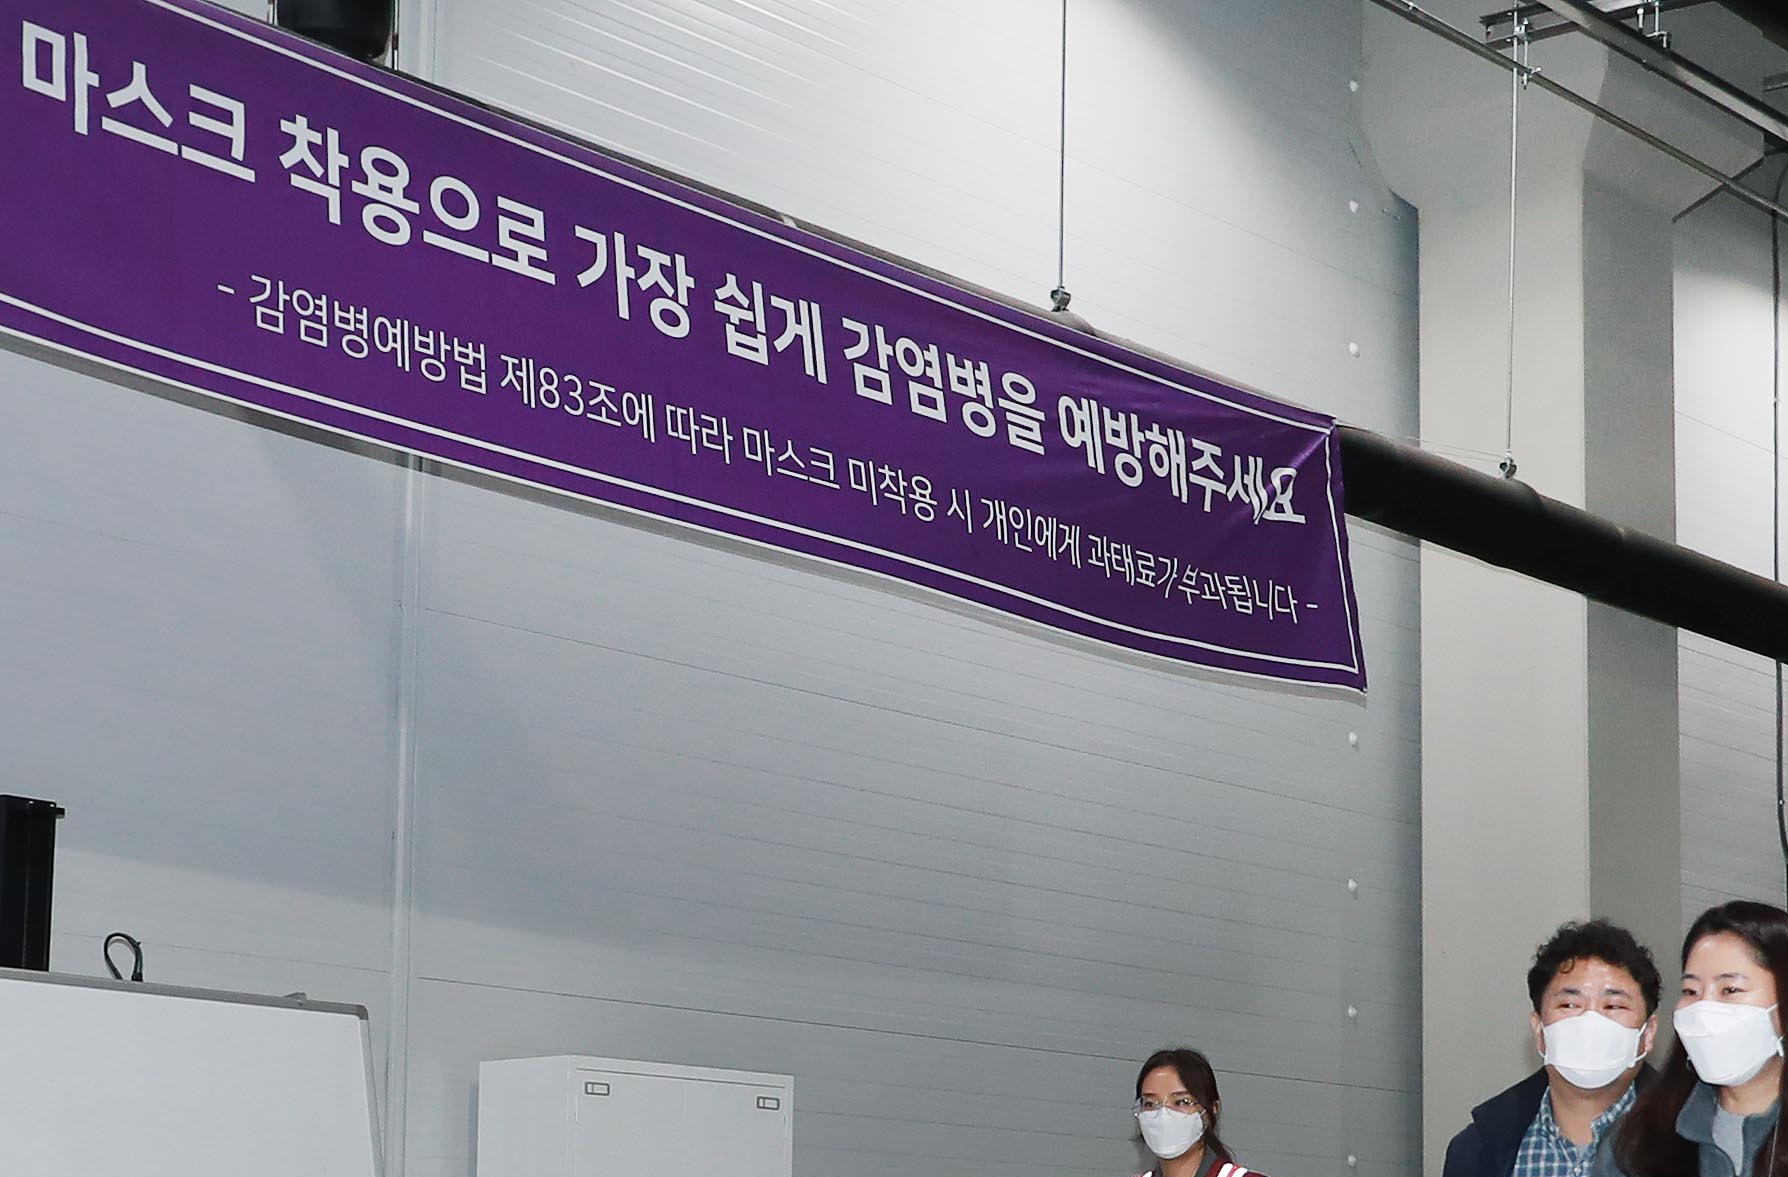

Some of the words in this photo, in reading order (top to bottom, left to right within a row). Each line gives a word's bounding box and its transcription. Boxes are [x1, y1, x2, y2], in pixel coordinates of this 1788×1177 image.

[22, 20, 256, 183] 마스크
[278, 113, 556, 286] 착용으로
[574, 224, 695, 338] 가장
[713, 272, 828, 385] 쉽게
[841, 317, 1046, 456] 감염병을
[1057, 395, 1306, 525] 예방해주세요
[249, 274, 487, 395] 감염병예방법
[500, 354, 656, 443] 제83조에
[665, 404, 734, 465] 따라
[742, 426, 841, 490] 마스크
[847, 458, 938, 522] 미착용
[946, 488, 973, 534] 시
[980, 498, 1082, 569] 개인에게
